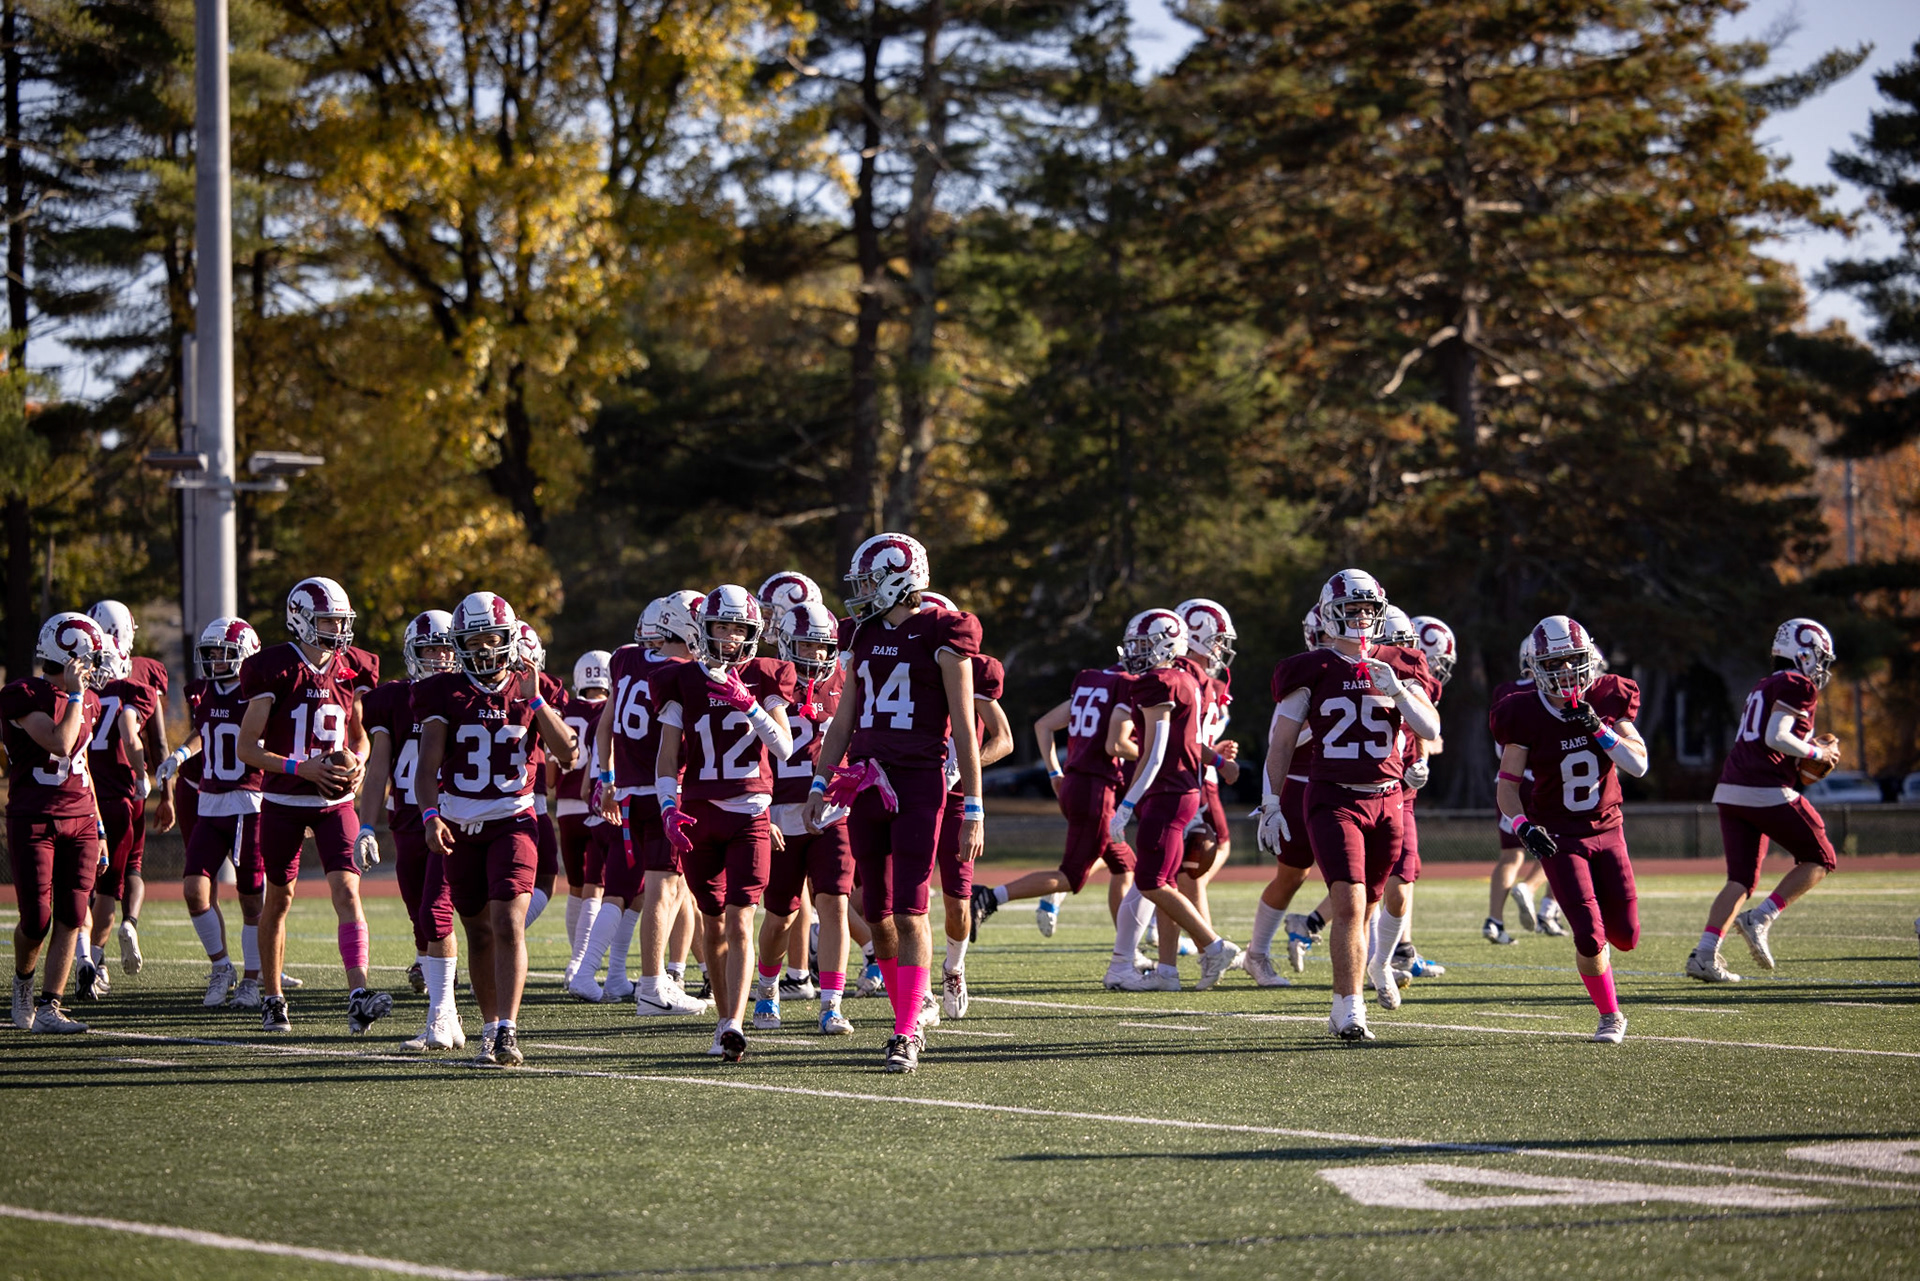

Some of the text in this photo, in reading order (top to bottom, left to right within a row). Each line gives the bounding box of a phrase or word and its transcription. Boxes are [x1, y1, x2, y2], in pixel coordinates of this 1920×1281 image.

[585, 666, 601, 678] 83
[871, 645, 898, 656] RAMS
[306, 688, 330, 698] RAMS
[613, 674, 652, 740] 16
[857, 660, 915, 730] 14
[1068, 686, 1109, 738] 56
[1342, 679, 1371, 690] RAMS
[210, 708, 230, 718] RAMS
[289, 702, 346, 760] 19
[477, 709, 507, 719] RAMS
[1320, 694, 1396, 759] 25
[200, 721, 246, 781] 10
[453, 724, 528, 793] 33
[694, 711, 760, 780] 12
[1560, 736, 1588, 750] RAMS
[1560, 750, 1600, 812] 8
